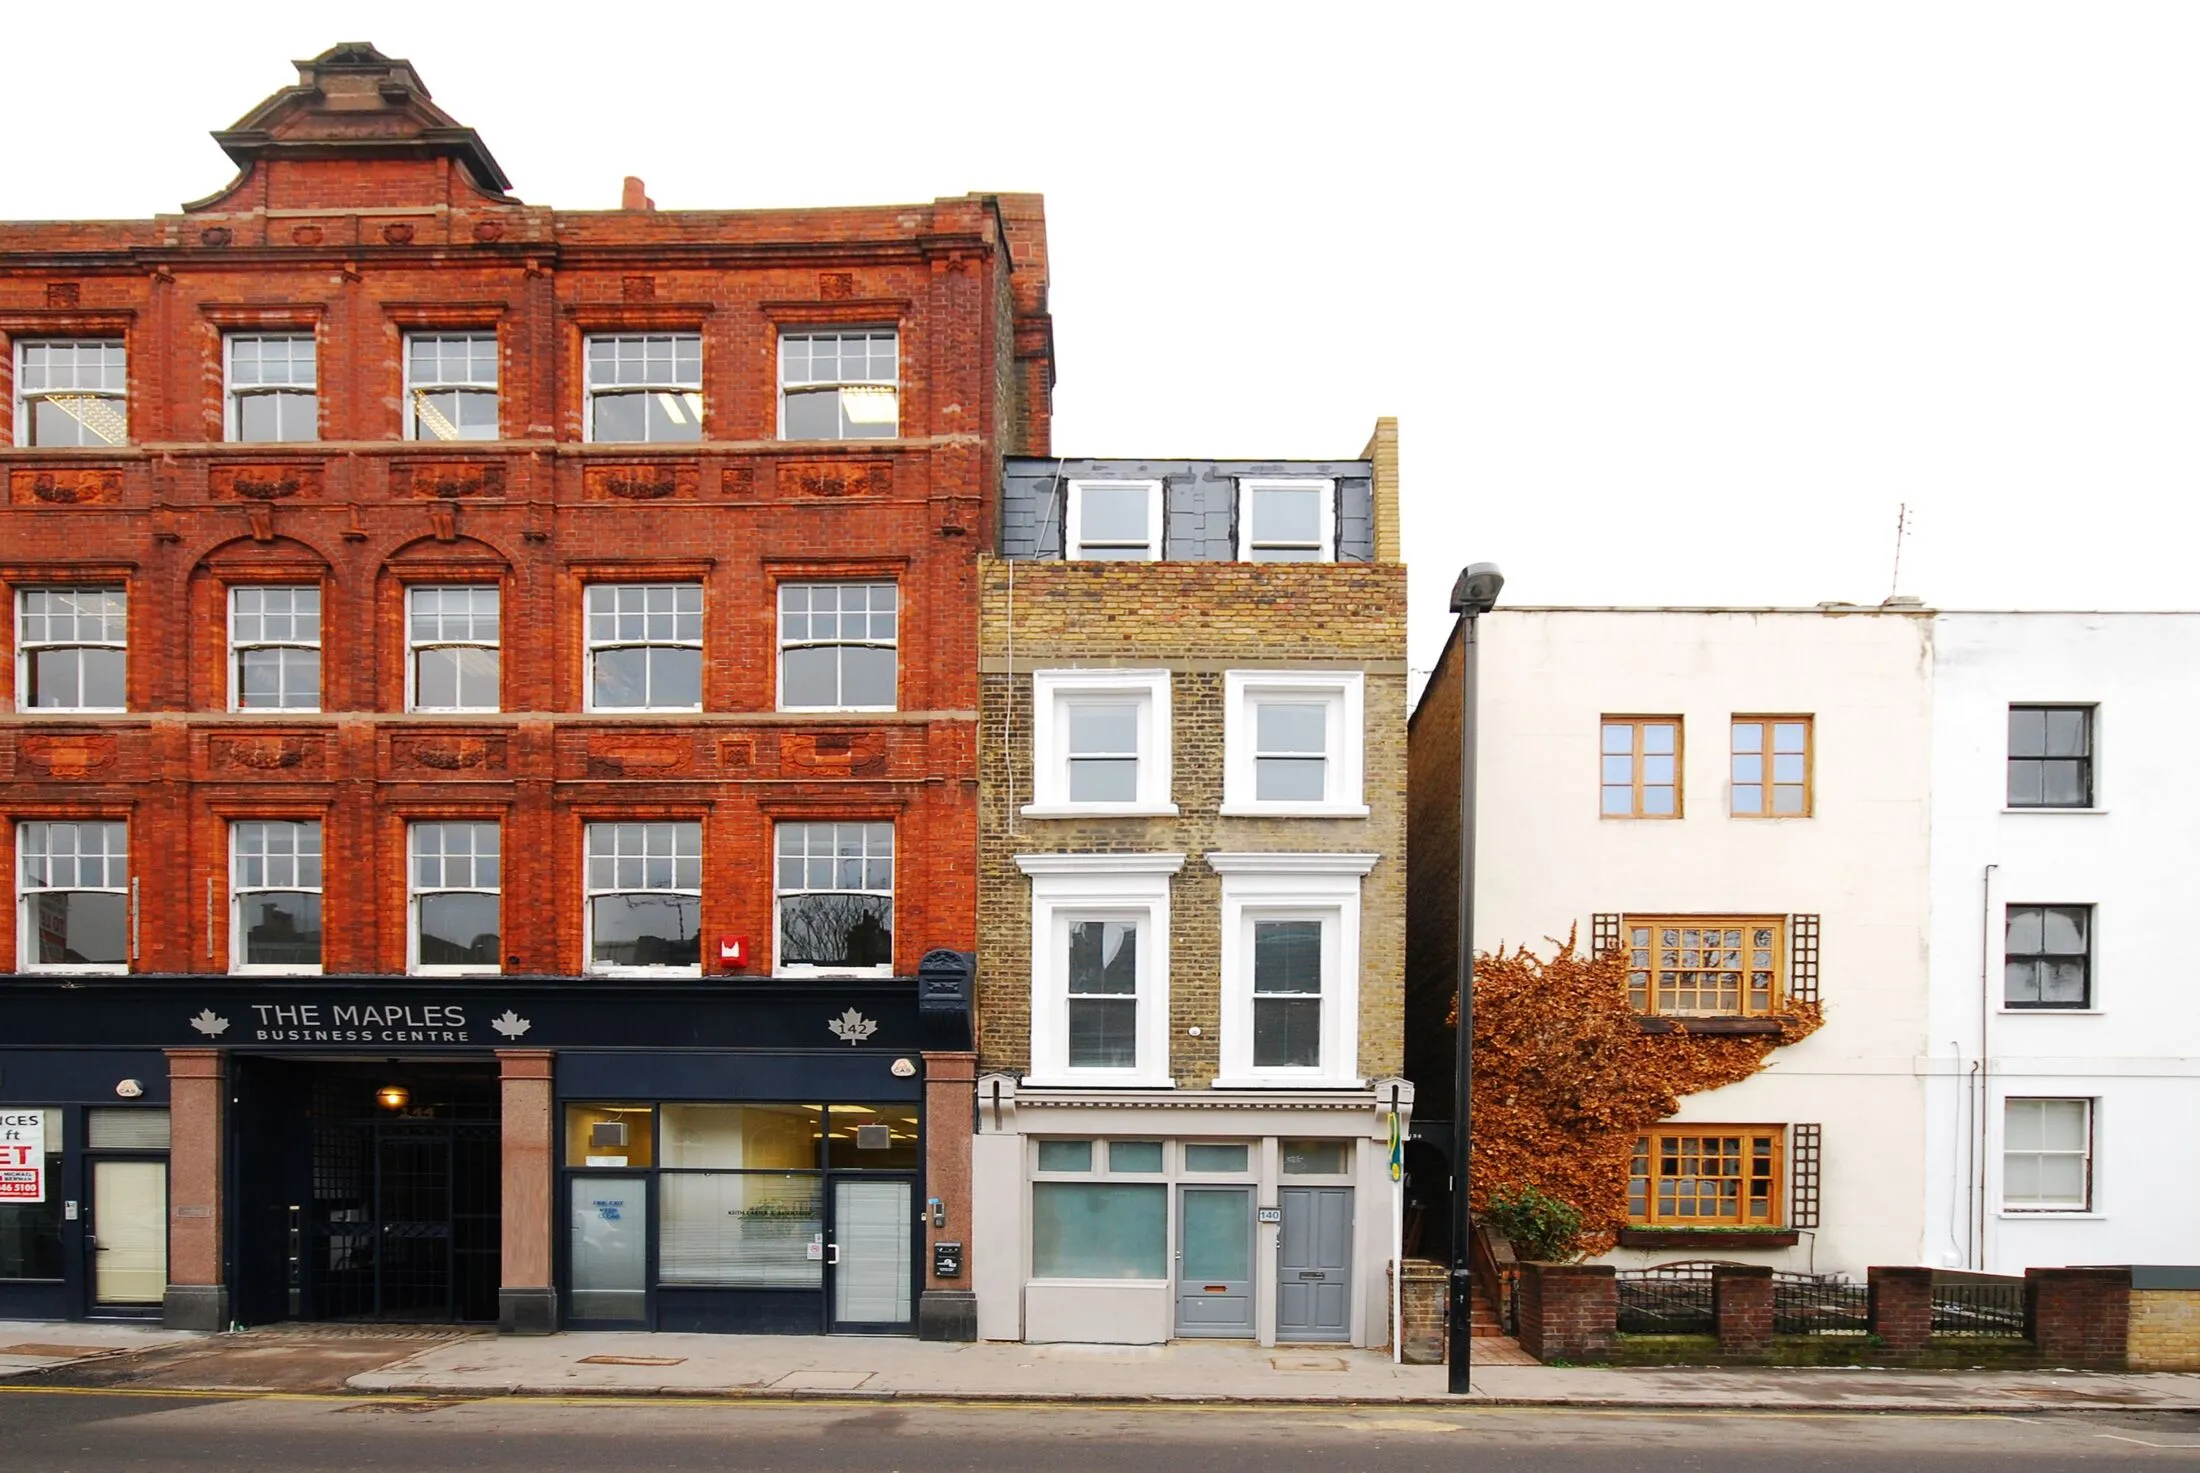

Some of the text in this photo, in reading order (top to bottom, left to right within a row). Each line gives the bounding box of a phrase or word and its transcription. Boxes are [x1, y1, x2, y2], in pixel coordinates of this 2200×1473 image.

[251, 1005, 466, 1027] THE MAPLES
[839, 1024, 867, 1035] 142
[256, 1030, 469, 1042] BUSINESS CENTRE
[0, 1115, 39, 1126] CES
[6, 1130, 20, 1140] ft
[13, 1183, 37, 1192] 5100
[1261, 1211, 1279, 1220] 140
